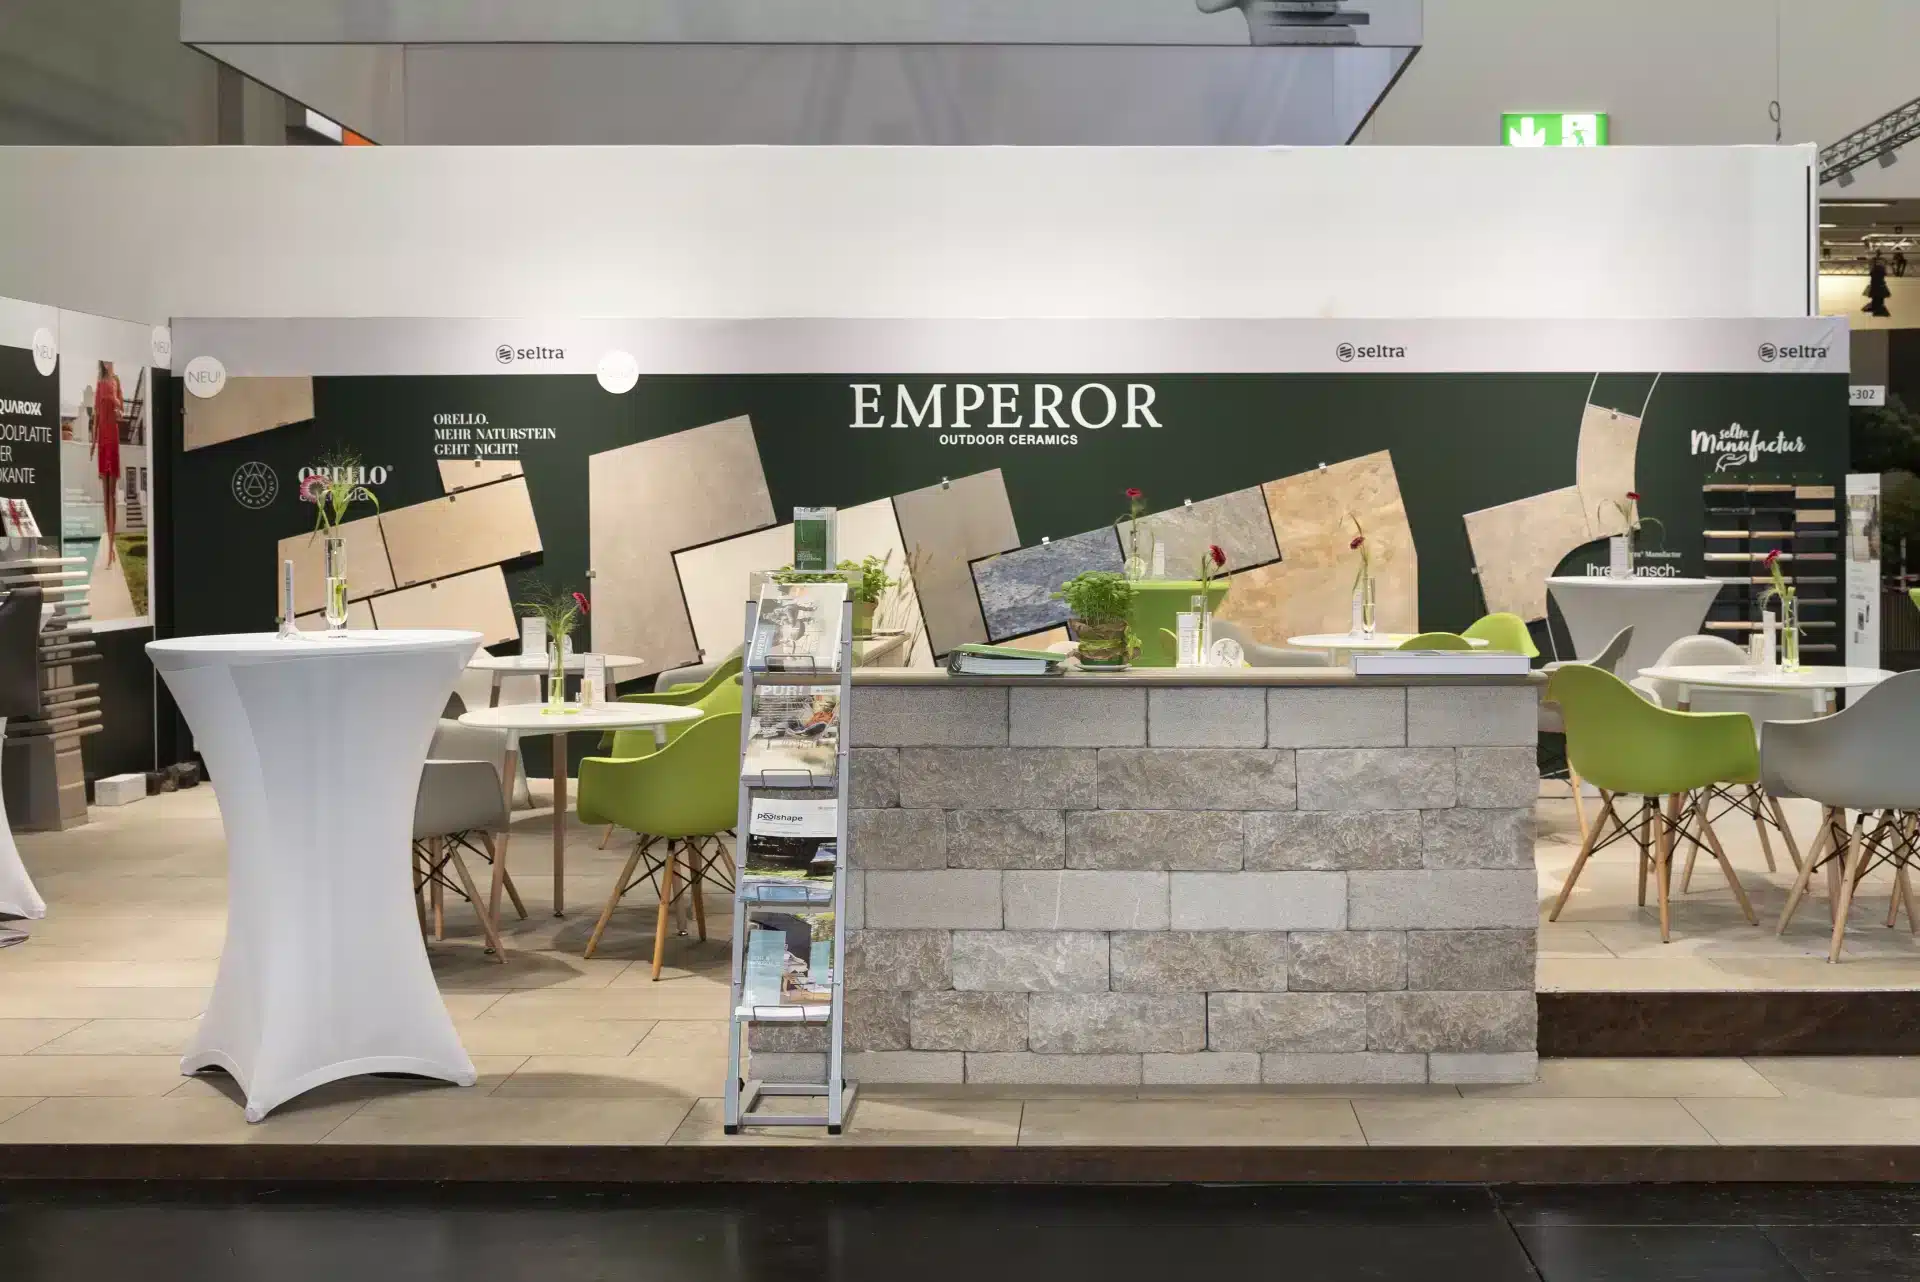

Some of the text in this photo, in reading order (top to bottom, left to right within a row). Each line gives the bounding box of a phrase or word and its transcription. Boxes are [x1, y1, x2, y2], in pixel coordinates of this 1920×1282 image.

[517, 346, 565, 360] seltra
[1357, 344, 1406, 358] seltra
[1779, 344, 1828, 359] seltra
[188, 370, 221, 384] NEU!
[1847, 388, 1876, 400] -302
[848, 382, 1163, 430] EMPEROR
[433, 413, 489, 426] ORELLO.
[434, 427, 557, 440] MEHR NATURSTEIN
[939, 434, 1079, 446] OUTDOOR CERAMICS
[434, 443, 519, 455] GEHT NICHT!
[1690, 428, 1807, 463] Manufactur
[0, 466, 36, 484] KANTE
[1586, 563, 1612, 577] Ihre
